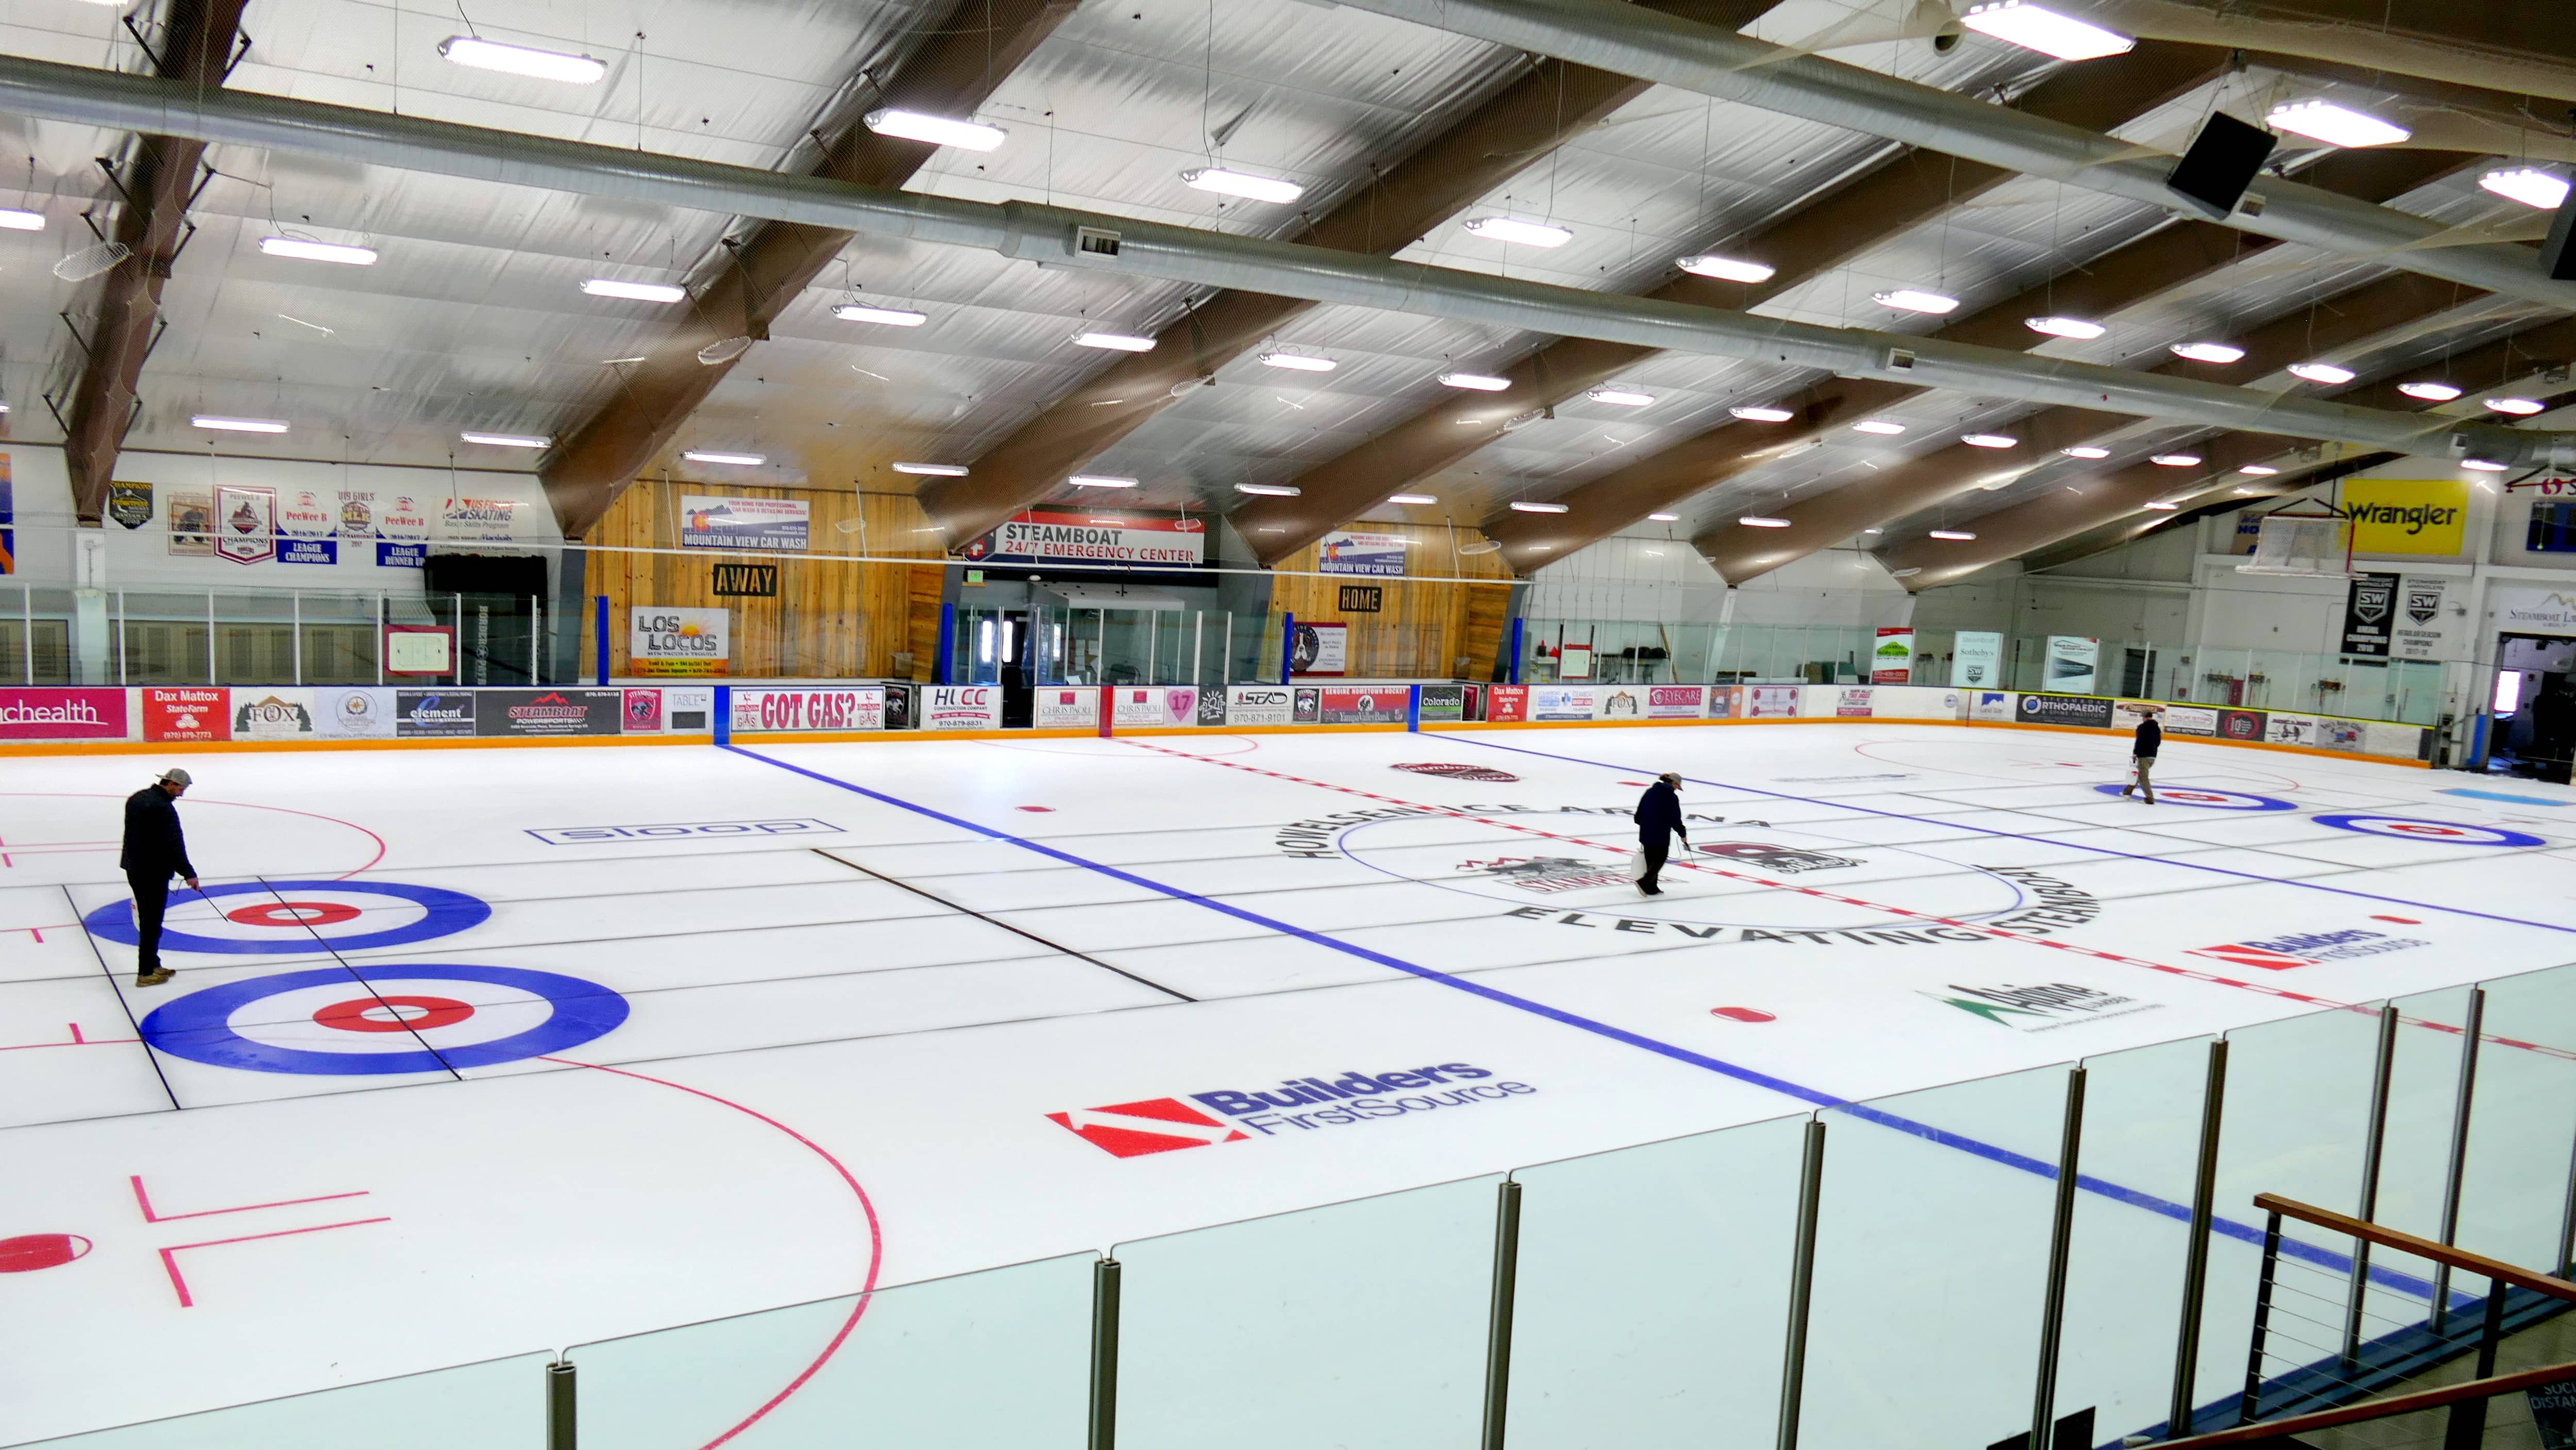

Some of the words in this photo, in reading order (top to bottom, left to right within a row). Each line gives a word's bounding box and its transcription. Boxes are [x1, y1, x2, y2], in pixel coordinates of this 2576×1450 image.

[338, 491, 351, 500] U19
[470, 499, 483, 509] US
[287, 511, 319, 522] PeeWee
[321, 513, 327, 522] B
[468, 508, 513, 521] SKATING
[2348, 501, 2458, 535] Wrangler
[386, 516, 416, 526] PeeWee
[418, 517, 424, 526] B
[483, 521, 509, 529] Program
[1005, 522, 1122, 546] STEAMBOAT
[293, 542, 322, 553] LEAGUE
[684, 534, 733, 546] MOUNTAIN
[735, 536, 759, 548] VIEW
[761, 537, 779, 549] CAR
[781, 538, 806, 550] WASH
[391, 547, 419, 556] LEAGUE
[1005, 540, 1037, 554] 24/7
[1044, 543, 1134, 559] EMERGENCY
[1140, 548, 1195, 562] CENTER
[285, 552, 329, 563] CHAMPIONS
[385, 555, 414, 566] RUNNER
[1320, 562, 1353, 572] MOUNTAIN
[1355, 564, 1370, 573] VIEW
[1372, 564, 1384, 574] CAR
[1385, 565, 1403, 575] WASH
[716, 567, 773, 593] AWAY
[1342, 588, 1378, 609] HOME
[2360, 592, 2384, 603] SW
[2412, 595, 2436, 607] SW
[2509, 608, 2561, 622] STEAMBOAT
[638, 615, 680, 633] LOS
[648, 633, 717, 651] LOCOS
[1960, 648, 1994, 657] Sotheby's
[155, 690, 178, 702] Dax
[180, 690, 219, 702] Mattox
[628, 690, 657, 699] STEAMBOAT
[1665, 689, 1700, 700] EYECARE
[2043, 696, 2107, 705] STEAMBOAT
[1173, 695, 1191, 711] 17
[1423, 697, 1460, 706] Colorado
[1611, 696, 1631, 708] FOX
[253, 704, 296, 722] FOX
[410, 707, 461, 718] element
[508, 705, 588, 719] STEAMBOAT
[761, 693, 802, 729] GOT
[807, 693, 856, 728] GAS?
[1042, 705, 1068, 715] CHRIS
[1117, 704, 1140, 713] CHRIS
[1234, 713, 1285, 722] 970-871-9101
[559, 821, 811, 840] sloop
[1276, 807, 1431, 860] HOWELSEN
[1436, 803, 1539, 813] ICE
[1560, 805, 1772, 828] ARNA
[1503, 905, 1994, 945] ELEVATING
[1970, 864, 2102, 935] STEAMBOAT
[2238, 929, 2387, 953] Builders
[1947, 982, 2109, 1013] Alpine
[1187, 1063, 1493, 1116] Builders
[1239, 1081, 1538, 1135] FirstSource
